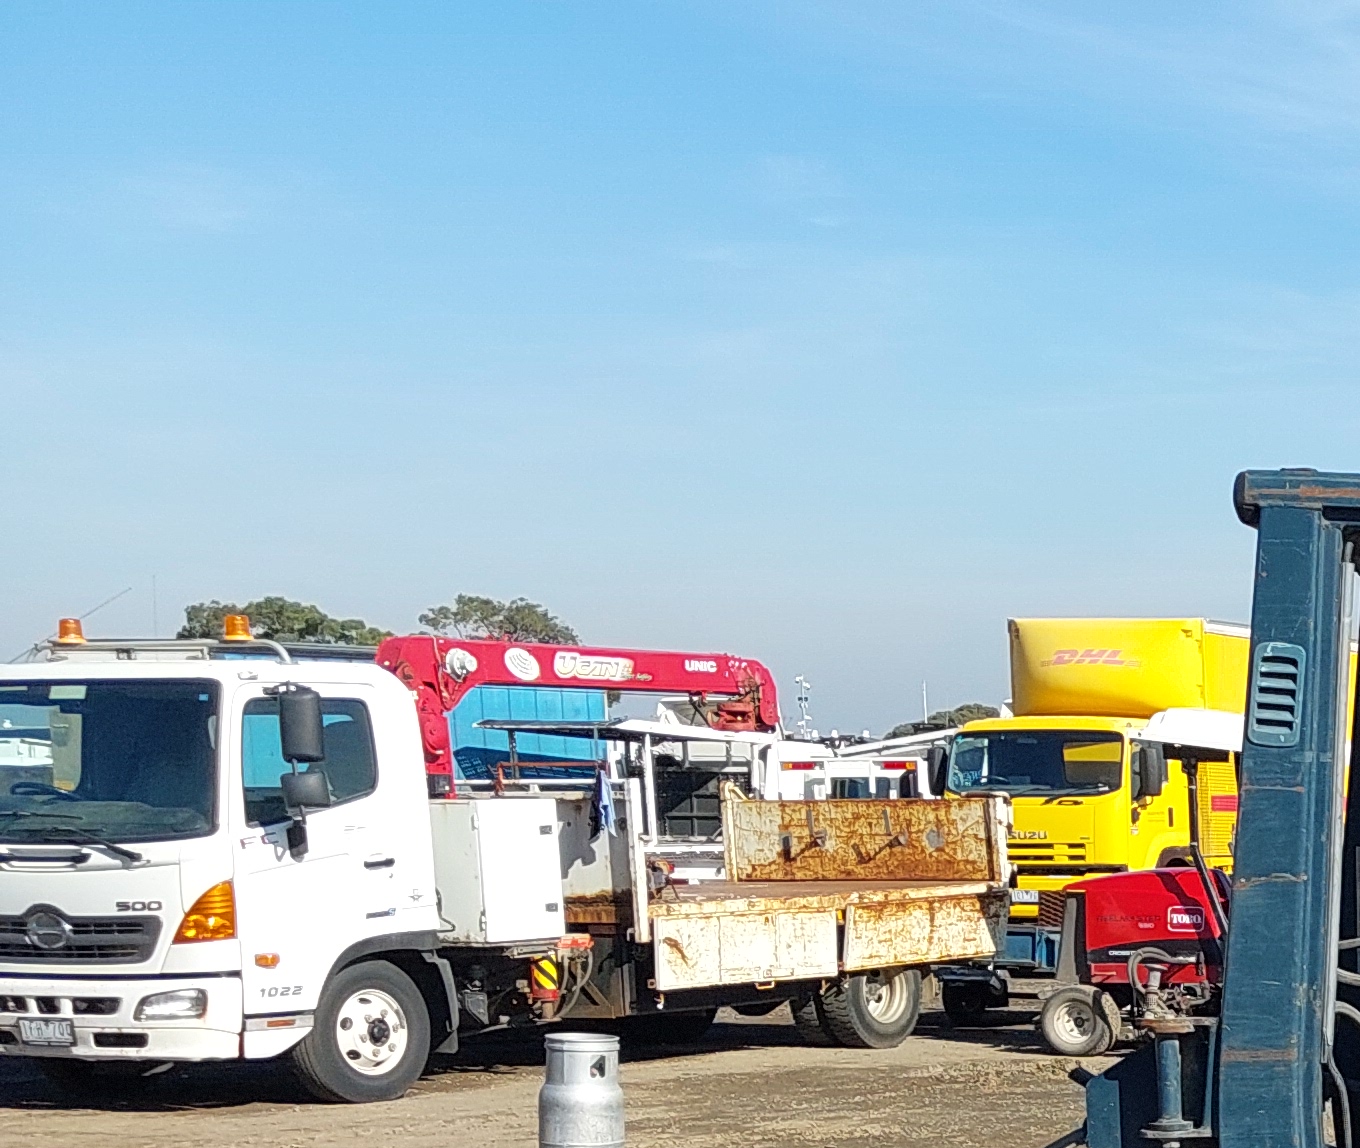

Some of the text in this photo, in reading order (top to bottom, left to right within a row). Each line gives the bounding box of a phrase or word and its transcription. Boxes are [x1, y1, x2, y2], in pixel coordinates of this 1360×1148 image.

[1052, 649, 1125, 666] DHL
[684, 659, 717, 673] UNIC
[1006, 830, 1048, 841] SUZU
[115, 901, 163, 912] 500
[1170, 913, 1203, 925] TORO
[259, 985, 304, 999] 1022
